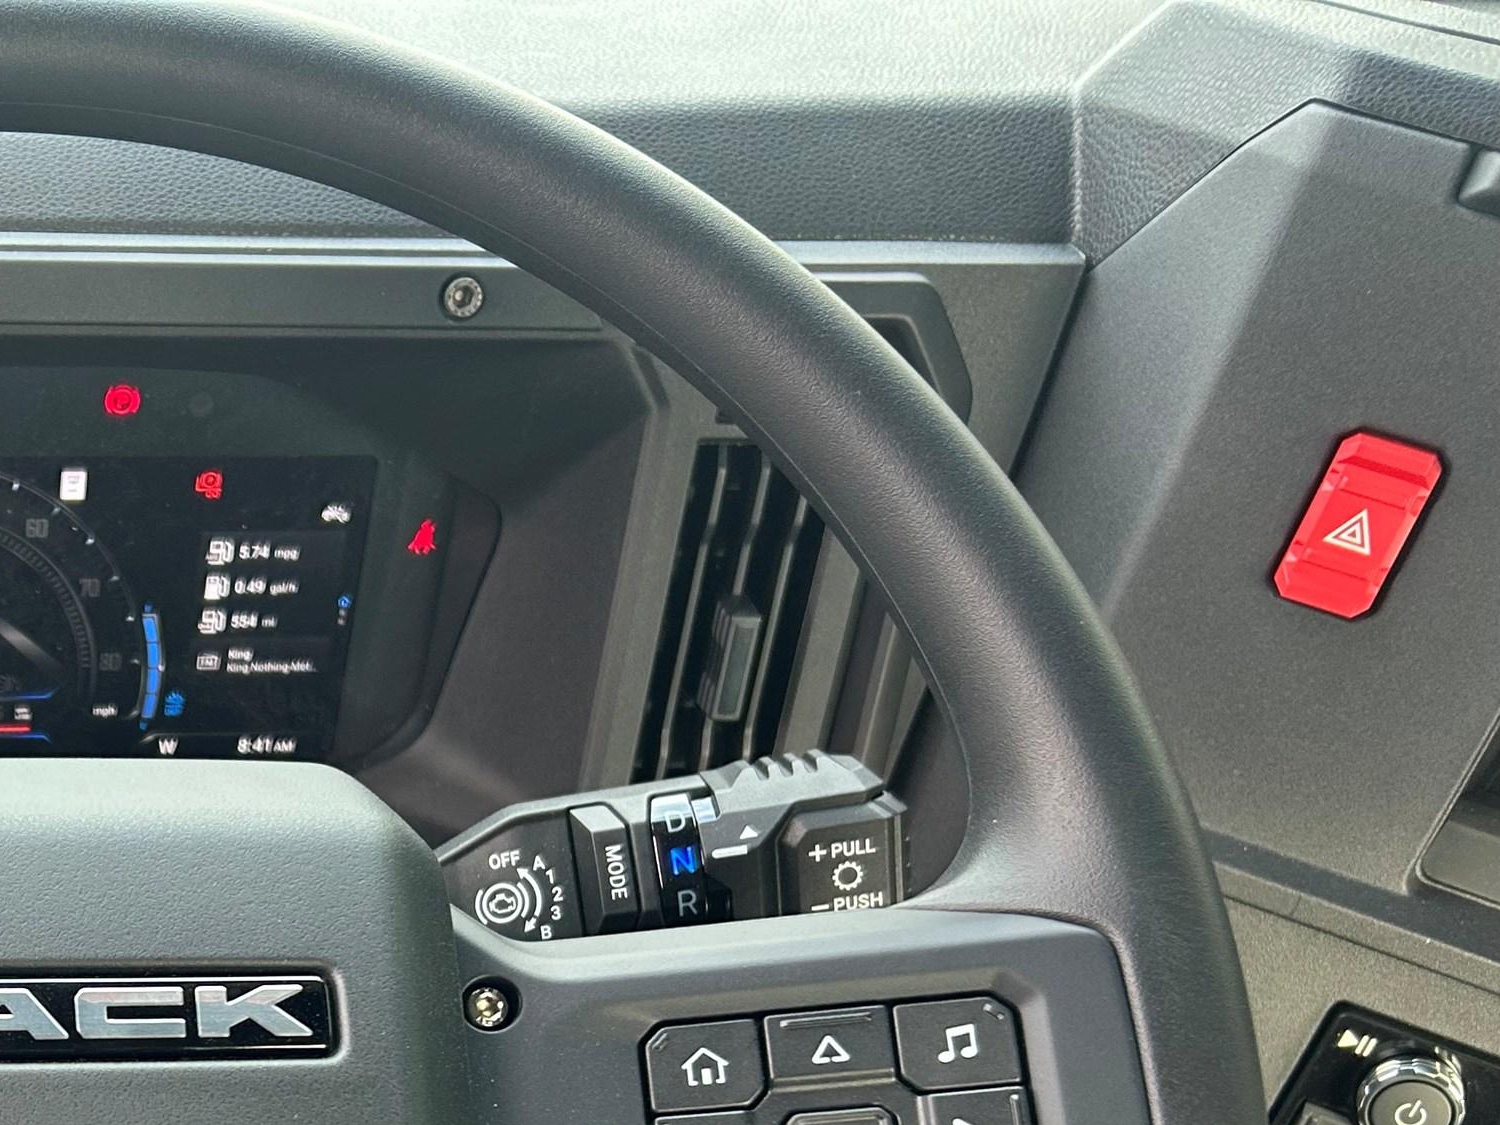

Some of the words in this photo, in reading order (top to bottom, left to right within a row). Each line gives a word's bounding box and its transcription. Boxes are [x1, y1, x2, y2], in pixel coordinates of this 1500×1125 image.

[26, 518, 49, 538] 60
[274, 547, 299, 560] mpg
[79, 578, 100, 597] 70
[228, 648, 253, 661] King
[227, 662, 250, 675] King
[92, 705, 117, 717] mph
[158, 738, 178, 755] W
[237, 736, 273, 753] 8:41
[273, 738, 296, 752] AM
[664, 811, 686, 833] D
[831, 838, 876, 859] PULL
[488, 850, 520, 870] OFF
[533, 855, 546, 871] A
[670, 846, 696, 876] N
[546, 869, 554, 884] 1
[604, 844, 628, 900] MODE
[551, 886, 564, 902] 2
[834, 891, 884, 913] PUSH
[677, 890, 699, 917] R
[550, 906, 562, 920] 3
[540, 925, 552, 940] B
